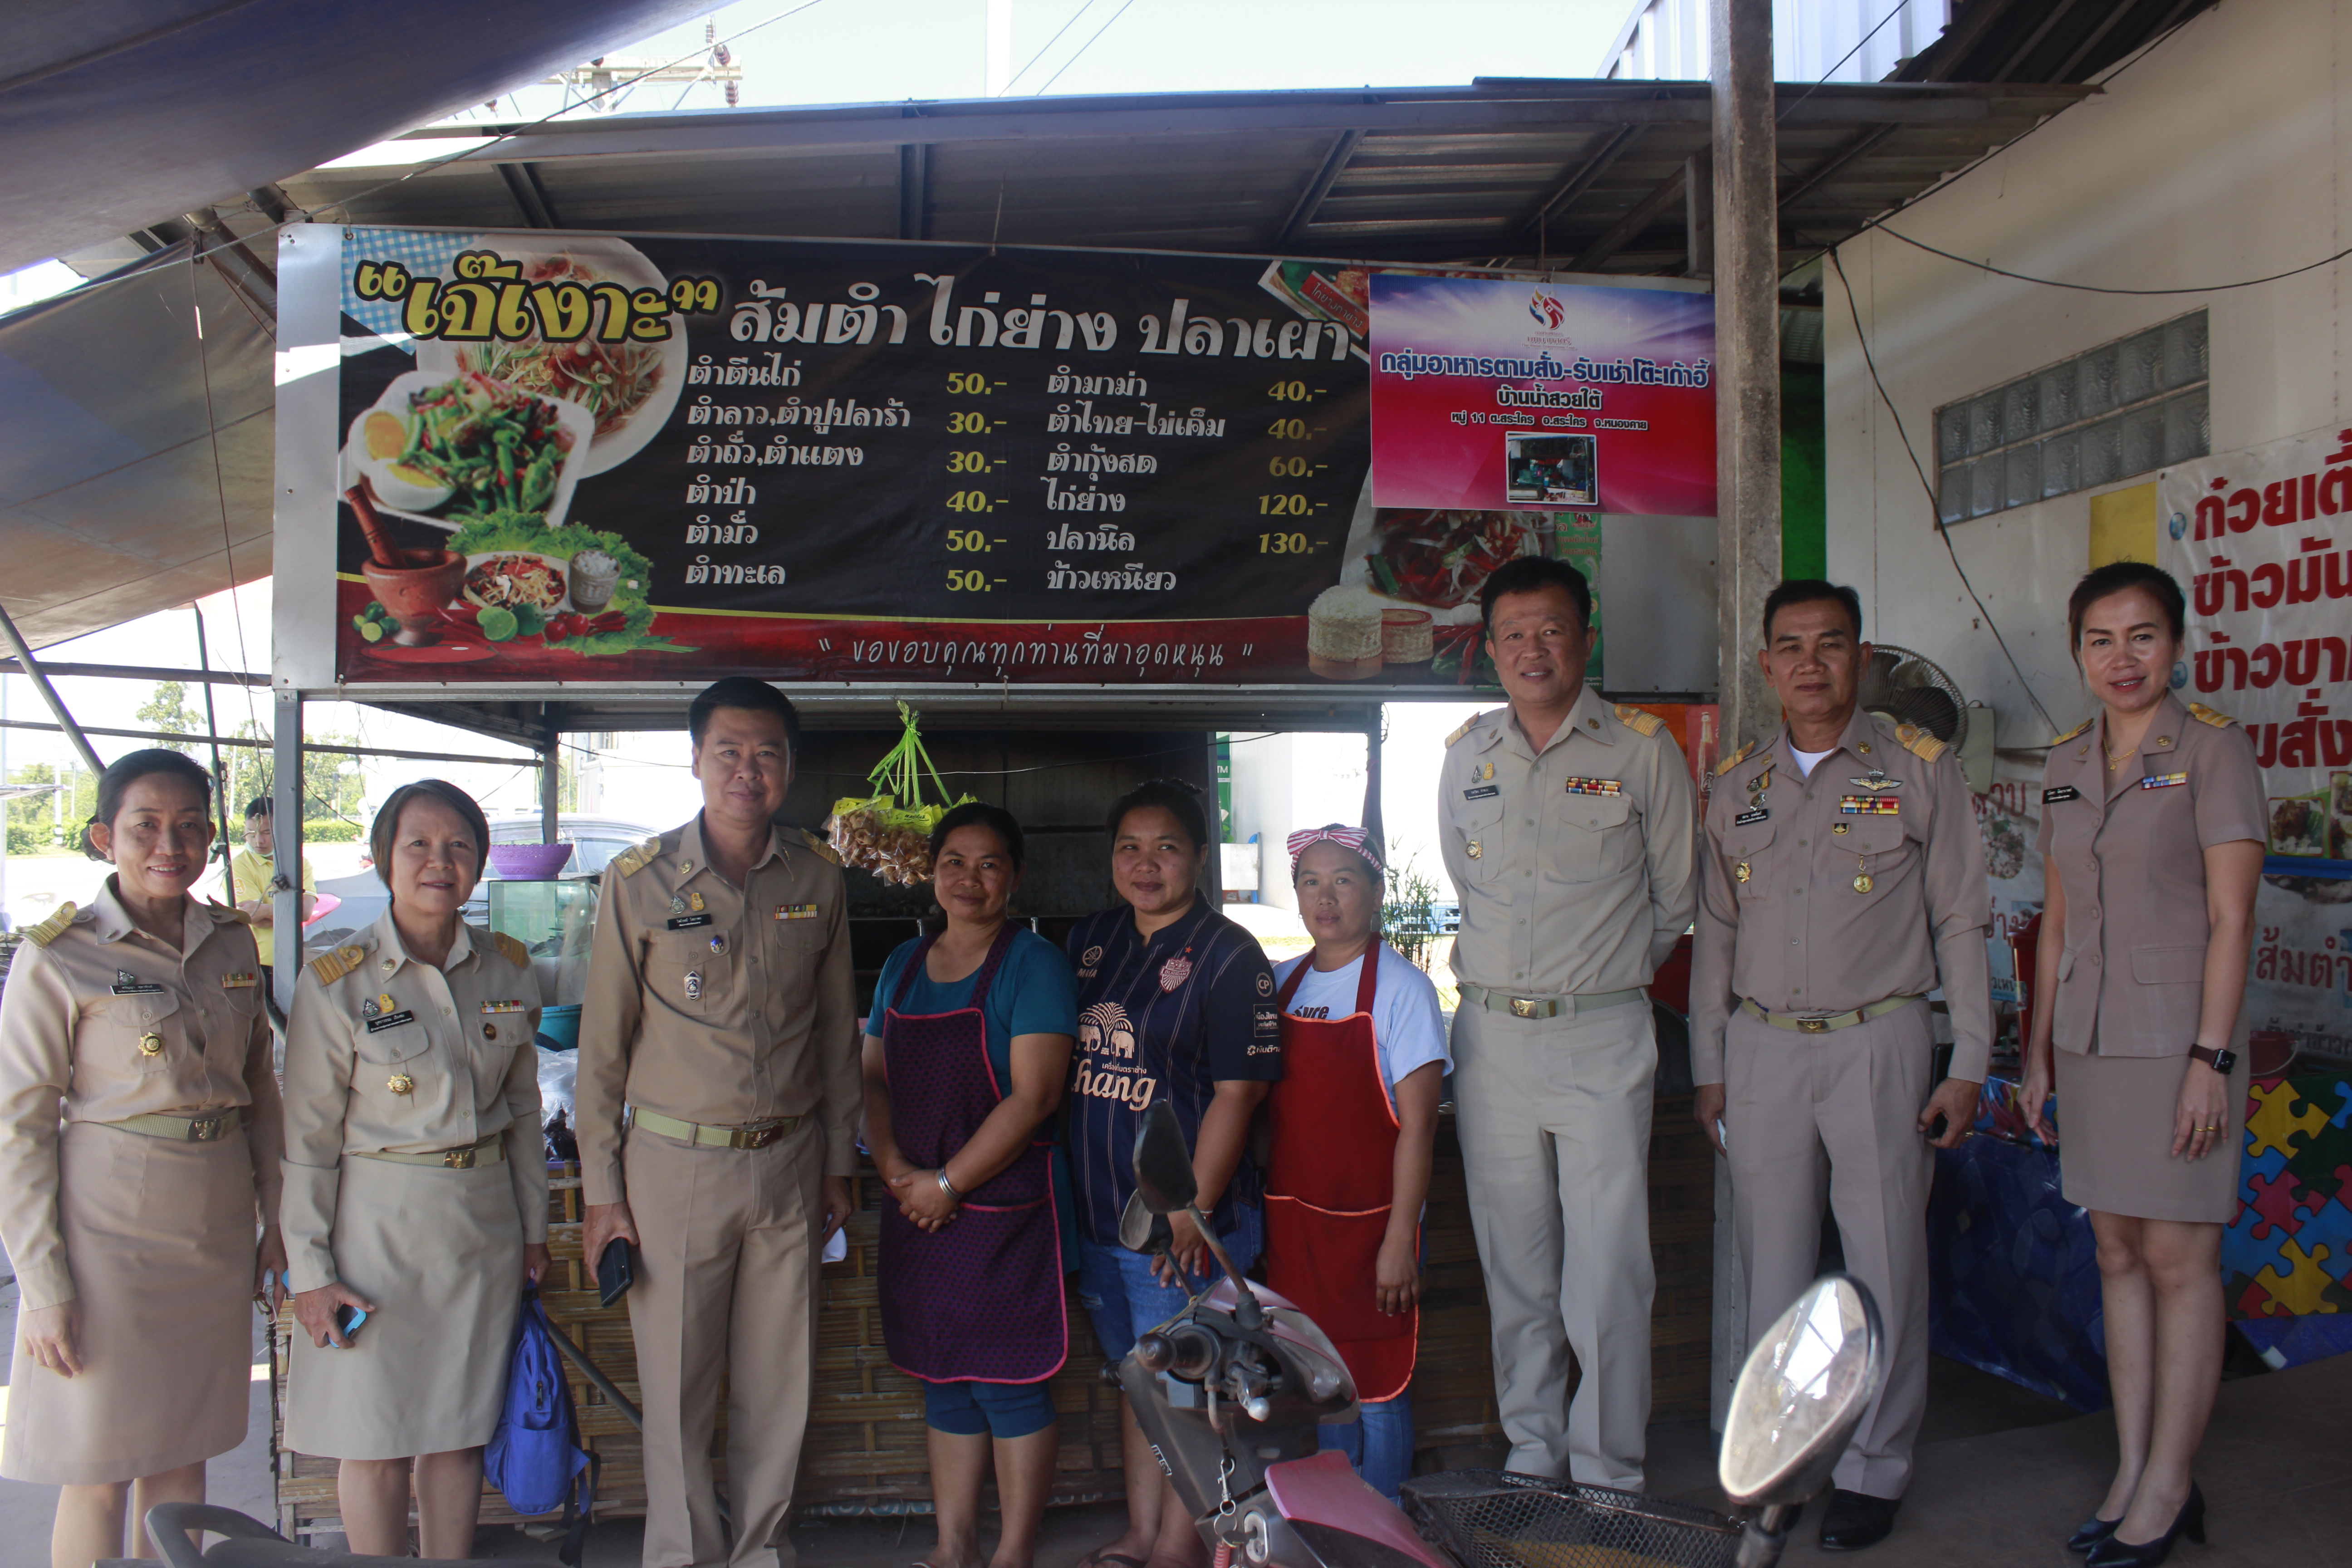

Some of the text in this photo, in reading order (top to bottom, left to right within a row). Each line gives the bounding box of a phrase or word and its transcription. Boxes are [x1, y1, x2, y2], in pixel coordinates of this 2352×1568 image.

[730, 272, 1350, 361] ส้มตำ ไก่ย่าง ปลาเผา
[687, 352, 1007, 395] ตำตีนไก่ 50.-
[1047, 365, 1327, 402] ตำมาม่า 40.-
[1380, 348, 1710, 388] กลุ่มอาหารตามสั่ง-รับเช่าโต๊ะเก้าอี้
[687, 395, 1007, 434] ตำลาว,ตำปูปลาร้า 30.-
[1497, 384, 1603, 410] บ้านน้ำสวยใต้
[1047, 399, 1327, 440] ตำไทย-ไข่เค็ม 40.-
[1451, 411, 1649, 431] หมู่ 11 ต.สระใคร อ.สระใคร จ.หนองคาย
[686, 430, 1007, 473] ตำถั่ว,ตำแตง 30.-
[1047, 443, 1328, 481] ตำกุ้งสด 60.-
[686, 474, 1009, 513] ตำป่า 40.-
[1040, 476, 1328, 516] ไก่ย่าง 120.-
[685, 510, 1007, 552] ตำมั่ว 50.-
[1047, 523, 1328, 554] ปลานิล 130.-
[685, 554, 1007, 592] ตำทะเล 50.-
[1047, 560, 1177, 591] ข้าวเหนียว
[853, 623, 1224, 677] ขอขอบคุณทุกท่านที่มาอุดหนุน
[2194, 631, 2352, 694] ข้าวขา
[2256, 926, 2352, 992] ส้มตำ
[1258, 979, 1270, 990] CP
[1071, 1055, 1156, 1111] hang
